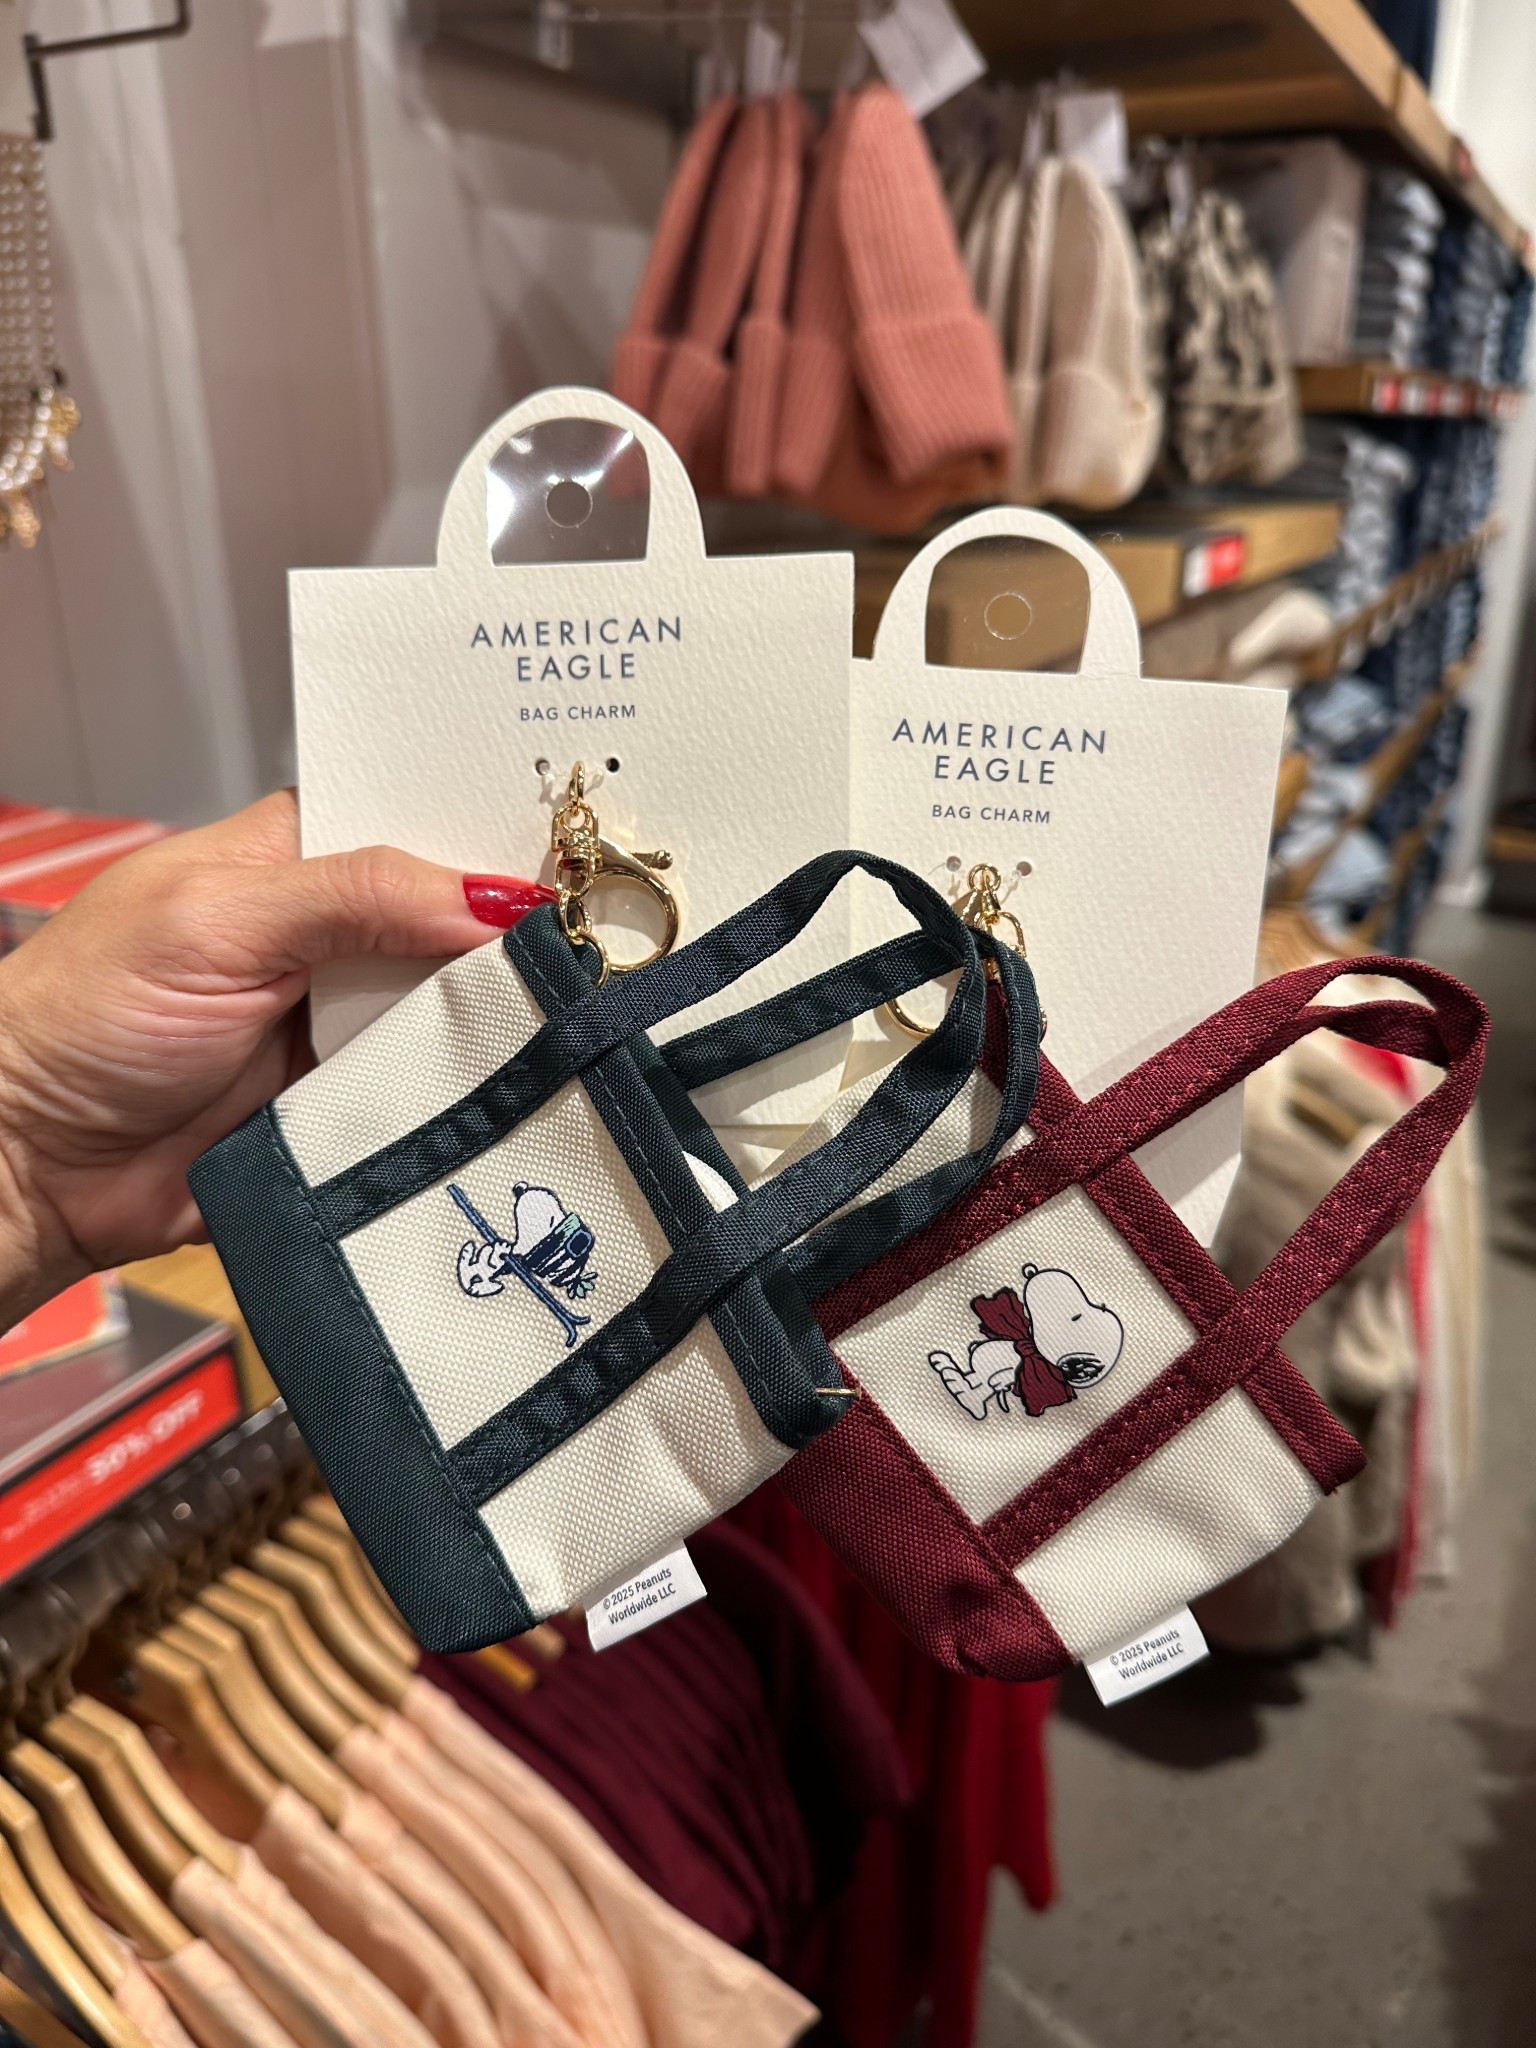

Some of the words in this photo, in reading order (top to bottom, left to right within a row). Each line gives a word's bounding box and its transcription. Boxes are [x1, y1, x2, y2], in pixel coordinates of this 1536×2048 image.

[471, 616, 681, 648] AMERICAN
[517, 652, 636, 682] EAGLE
[519, 706, 559, 721] BAG
[568, 704, 637, 720] CHARM
[891, 718, 1106, 754] AMERICAN
[934, 754, 1055, 785] EAGLE
[931, 804, 971, 819] BAG
[980, 807, 1050, 824] CHARM
[635, 1568, 672, 1592] Peanuts
[608, 1594, 658, 1624] Worldwide
[658, 1583, 676, 1599] LLC
[1143, 1629, 1180, 1652] Peanuts
[1119, 1653, 1167, 1679] Worldwide
[1167, 1642, 1184, 1658] LLC
